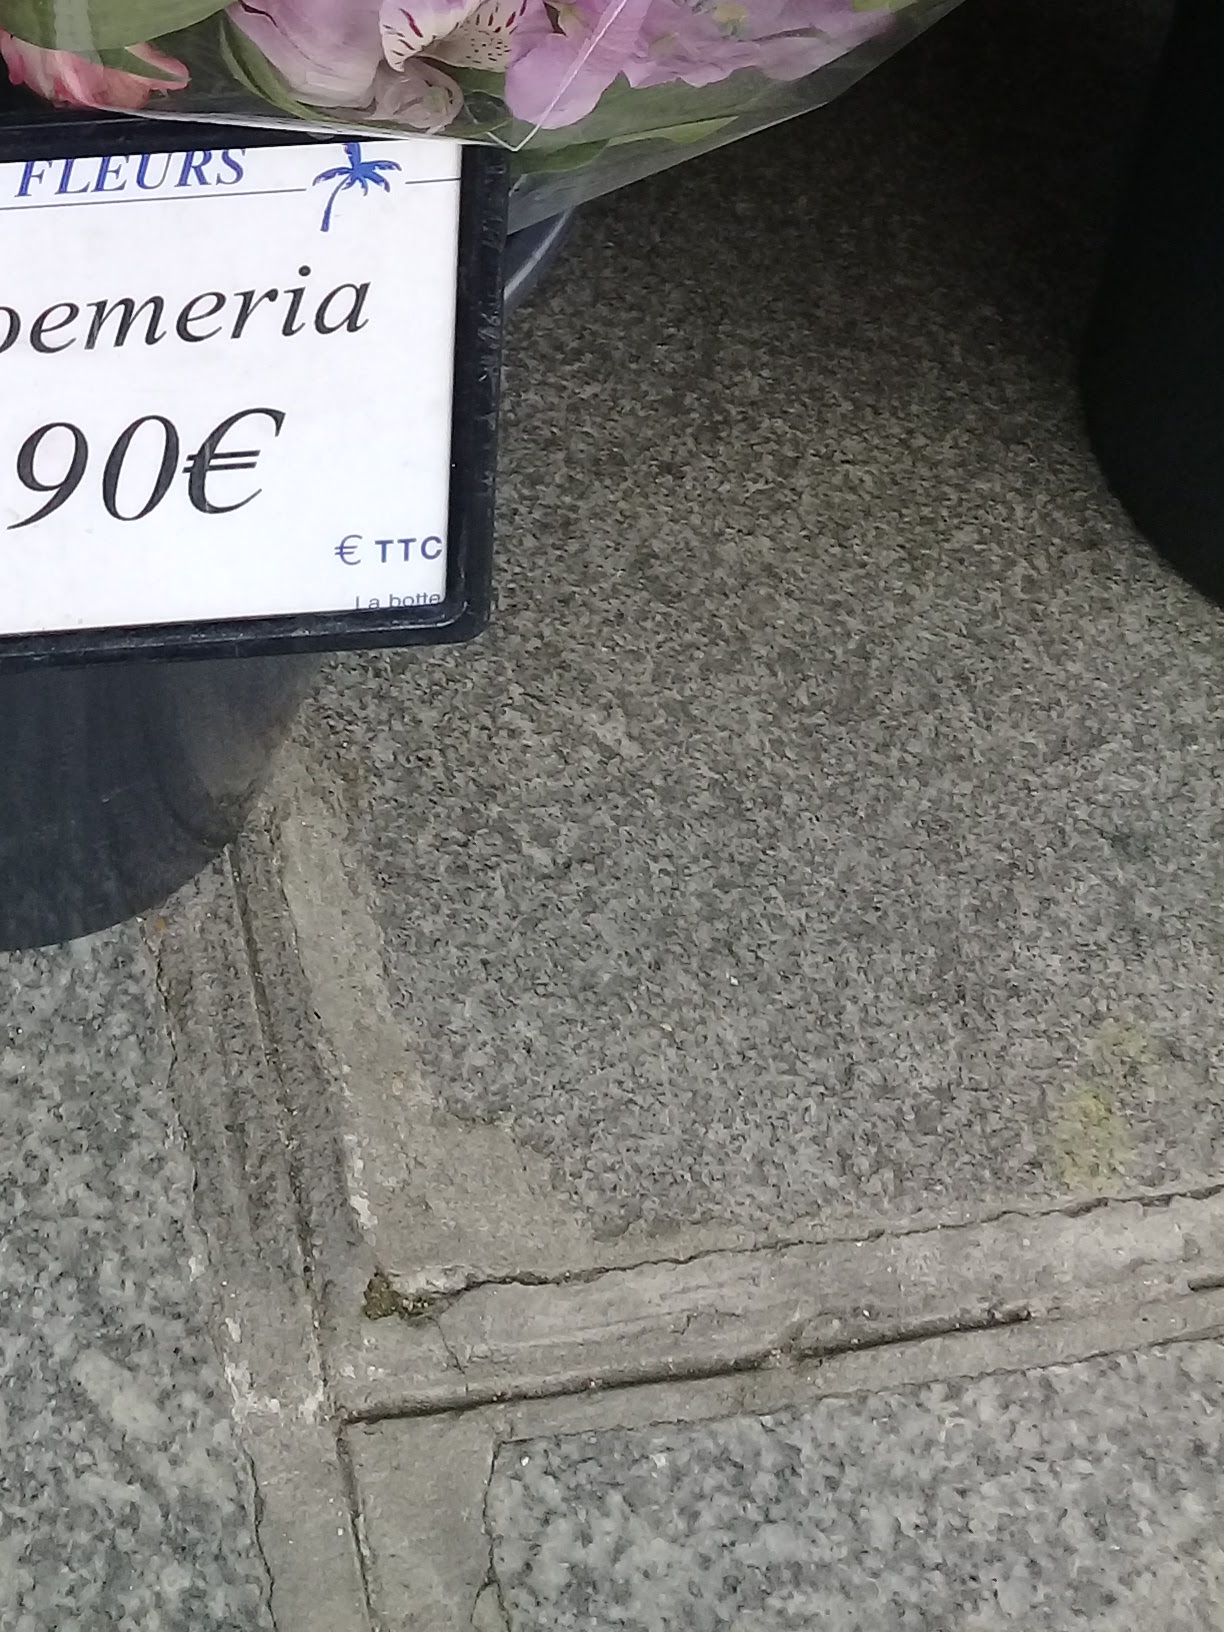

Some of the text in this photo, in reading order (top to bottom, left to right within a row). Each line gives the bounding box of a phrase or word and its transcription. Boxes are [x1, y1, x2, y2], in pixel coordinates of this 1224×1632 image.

[13, 148, 247, 197] FLEURS
[334, 534, 443, 566] € TTC
[389, 592, 441, 607] botte
